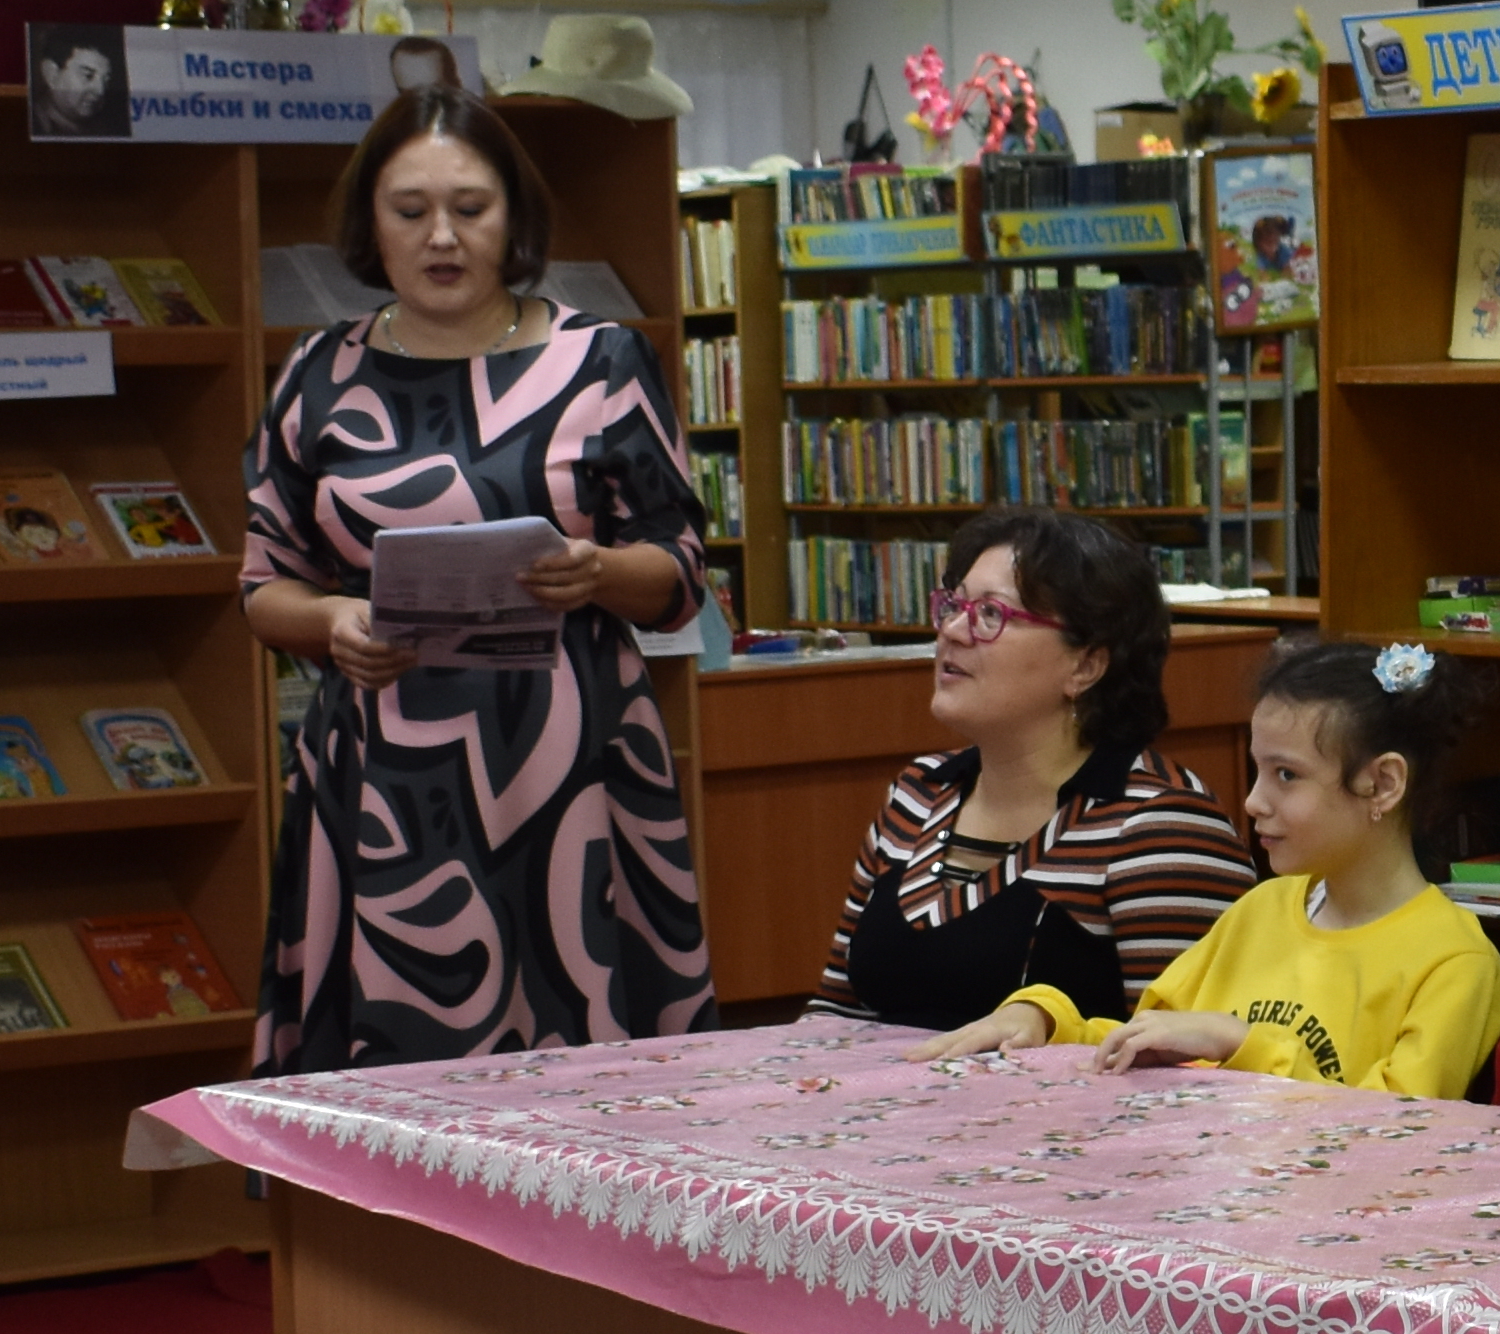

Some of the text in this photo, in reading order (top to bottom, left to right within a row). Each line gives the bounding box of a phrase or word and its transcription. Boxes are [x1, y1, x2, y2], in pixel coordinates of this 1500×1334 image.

[184, 53, 315, 82] Мастера
[130, 92, 374, 122] улыбки и смеха
[1020, 214, 1166, 247] ФАНТАСТИКА
[24, 352, 88, 368] щедрый
[1247, 999, 1304, 1027] GIRLS
